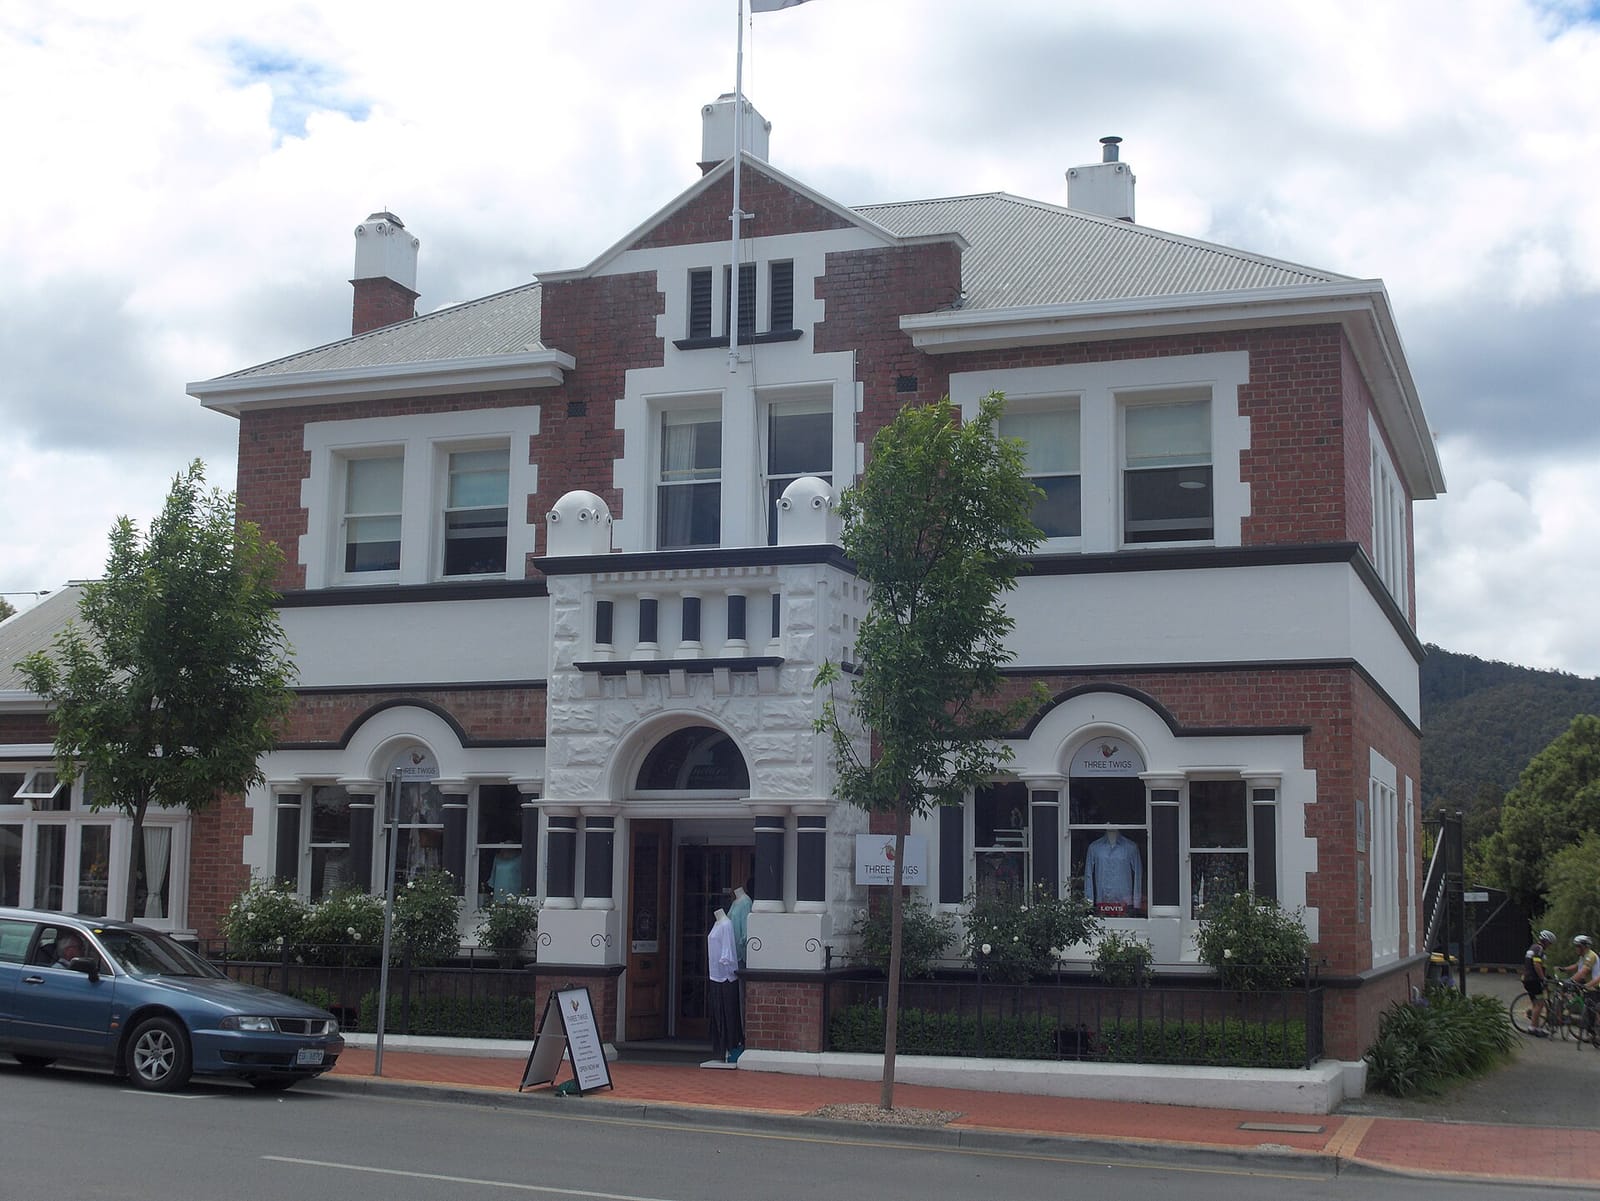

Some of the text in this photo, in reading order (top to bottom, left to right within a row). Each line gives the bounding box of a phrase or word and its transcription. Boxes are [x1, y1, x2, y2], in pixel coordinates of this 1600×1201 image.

[1084, 760, 1132, 769] THREE TWIGS
[864, 864, 891, 874] THREE
